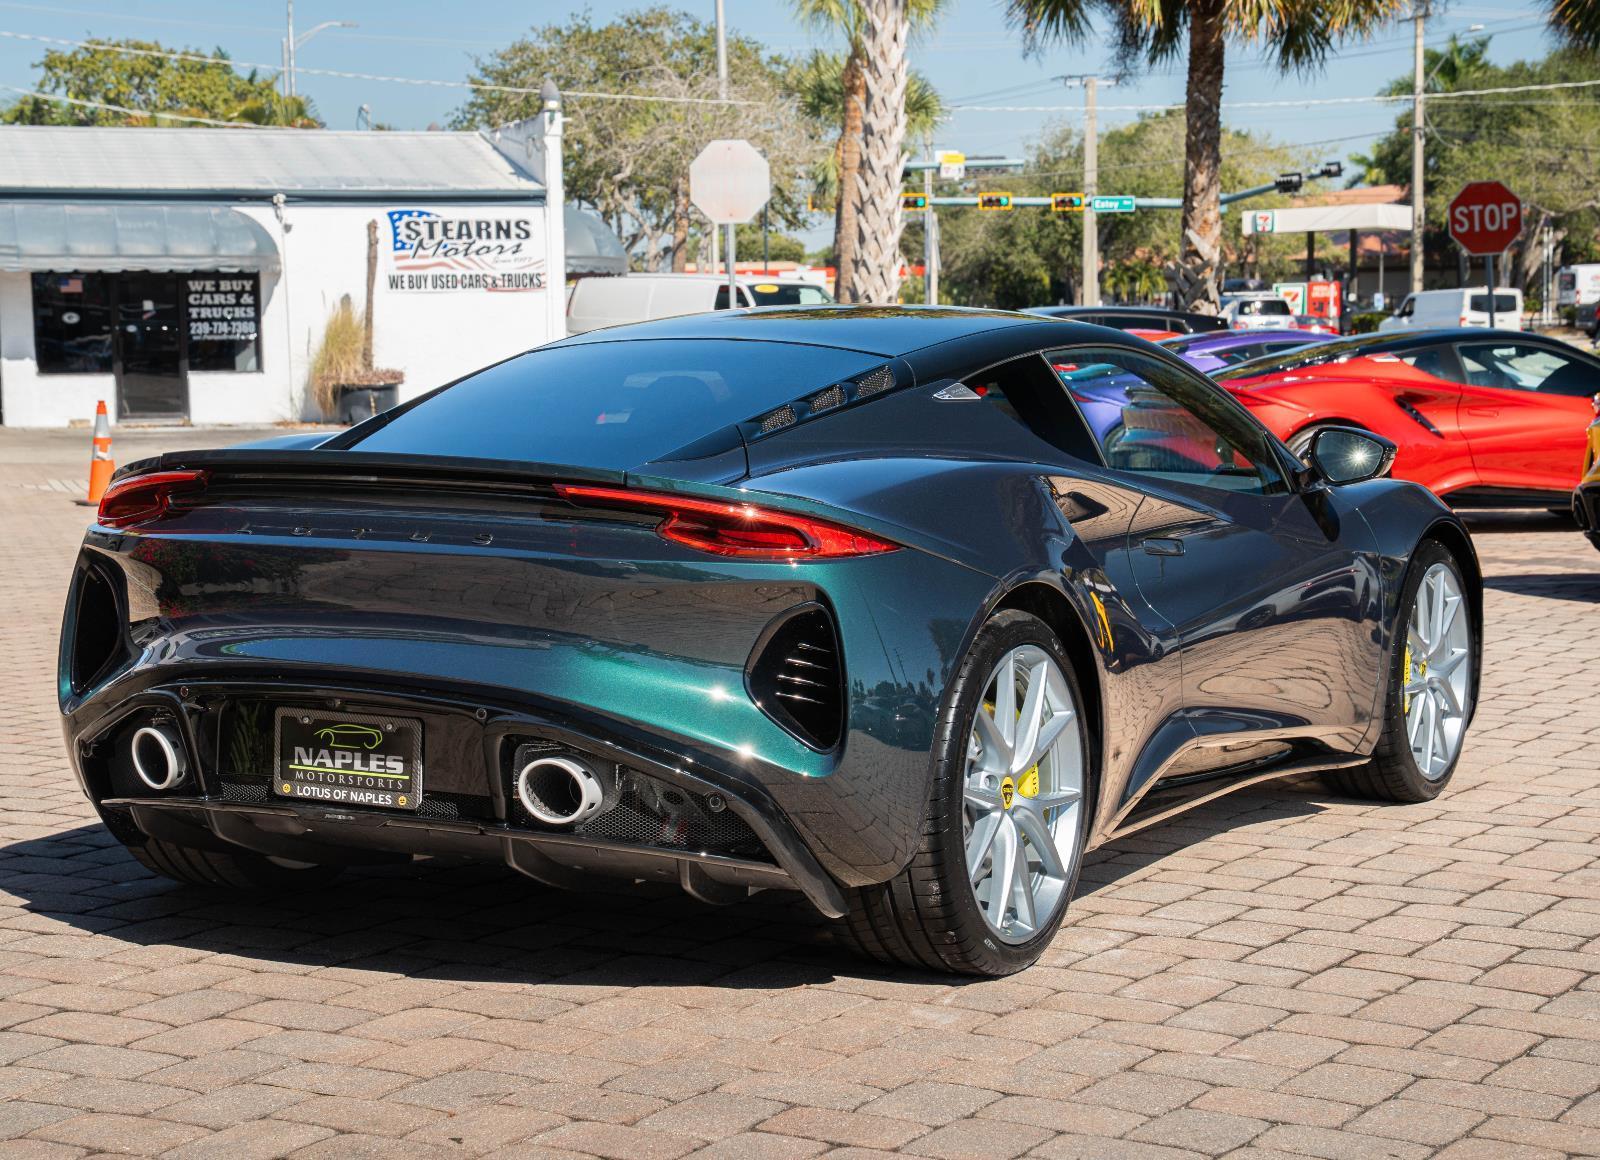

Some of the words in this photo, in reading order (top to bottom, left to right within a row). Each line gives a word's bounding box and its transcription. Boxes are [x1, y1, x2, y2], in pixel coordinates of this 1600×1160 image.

[1454, 202, 1518, 234] STOP
[404, 219, 531, 241] STEARNS
[411, 238, 524, 259] Motors
[187, 280, 216, 292] WE
[219, 280, 253, 291] BUY
[388, 274, 405, 290] WE
[408, 274, 428, 289] BUY
[432, 273, 458, 289] USED
[461, 273, 488, 289] CARS
[491, 276, 498, 288] &
[500, 272, 542, 288] TRUCKS
[188, 293, 236, 305] CARS
[240, 293, 255, 304] &
[188, 306, 255, 319] TRUCKS
[236, 523, 494, 546] LOTUS
[294, 746, 404, 774] NAPLES
[295, 771, 403, 790] MOTORSPORTS
[296, 785, 332, 799] LOTUS
[333, 789, 348, 800] OF
[349, 792, 392, 805] NAPLES
